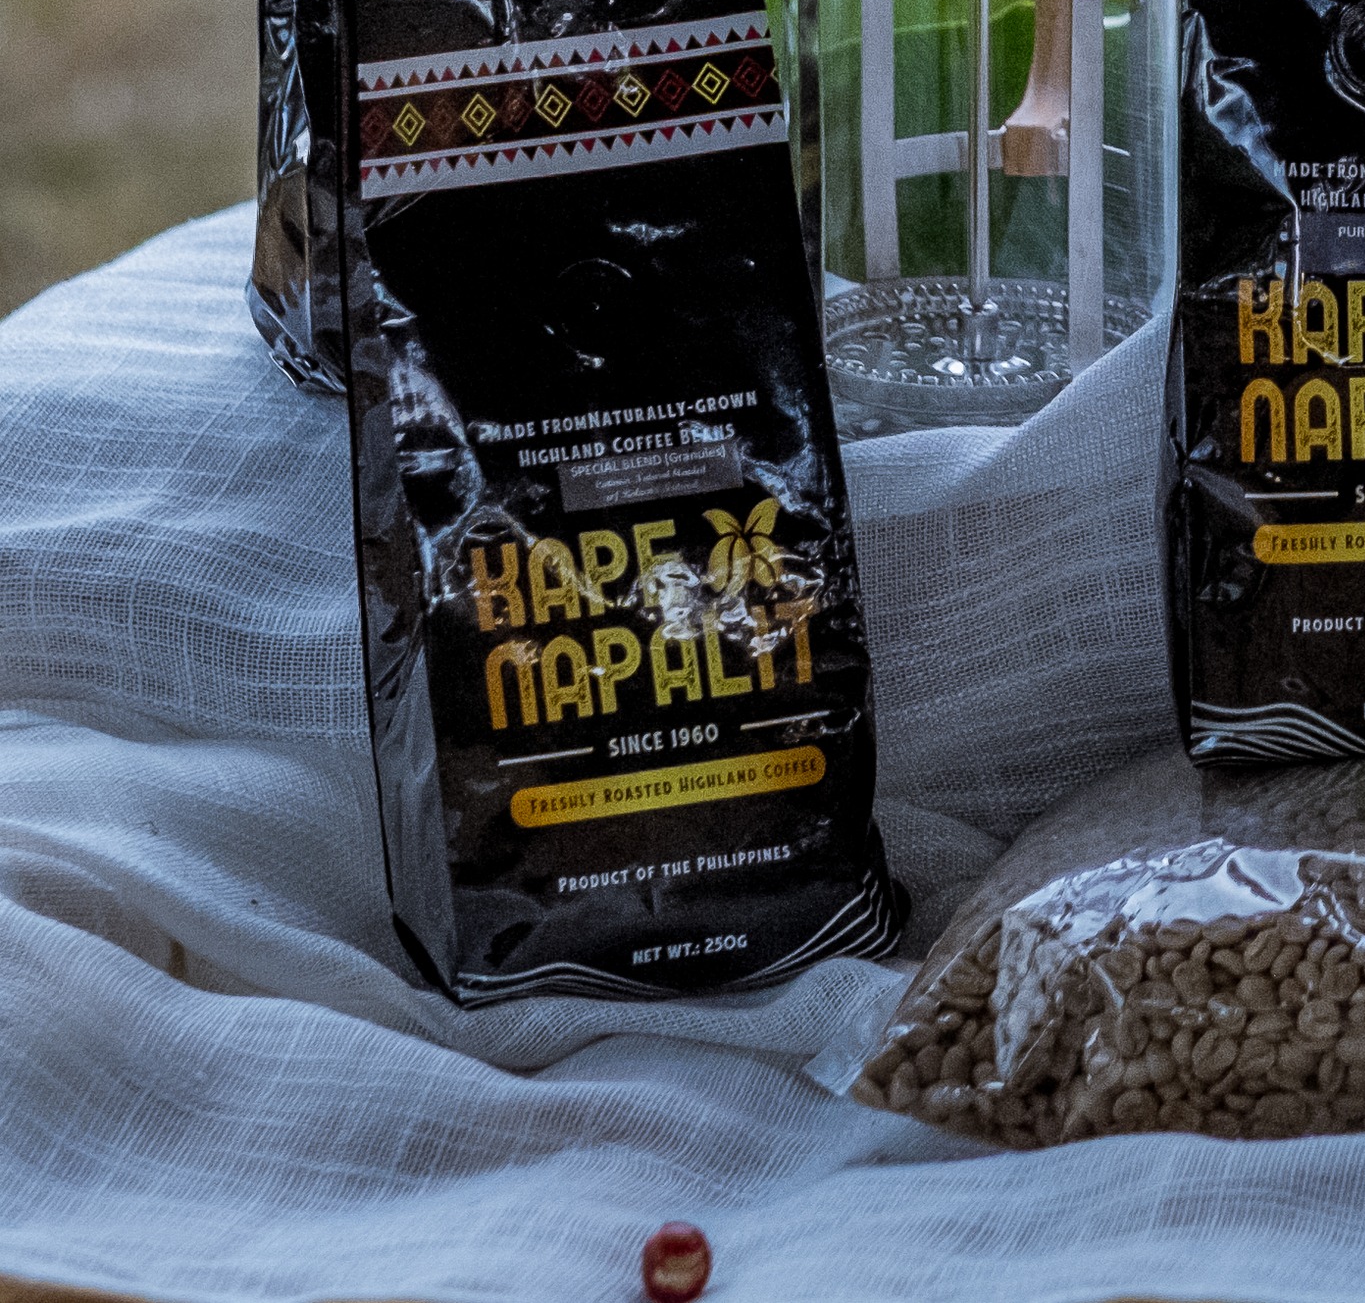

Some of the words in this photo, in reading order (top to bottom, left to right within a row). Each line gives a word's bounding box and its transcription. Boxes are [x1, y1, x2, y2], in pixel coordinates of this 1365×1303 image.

[518, 446, 605, 467] HIGHLAND
[612, 435, 673, 454] COFFEE
[570, 461, 620, 478] SPECIAL
[1271, 535, 1337, 551] FRESHLY
[470, 519, 683, 632] KAPE
[1292, 616, 1362, 633] PRODUCT
[485, 598, 820, 730] NAPALIT
[609, 733, 664, 757] SINCE
[670, 723, 719, 748] 1960
[530, 795, 596, 815] FRESHLY
[605, 782, 672, 803] ROASTED
[679, 768, 757, 792] HIGHLAND
[764, 759, 816, 779] COFFEE
[558, 870, 630, 892] PRODUCT
[637, 866, 656, 881] OF
[662, 862, 690, 877] THE
[697, 845, 791, 872] PHILIPPINES
[632, 949, 661, 965] NET
[704, 935, 748, 954] 250G
